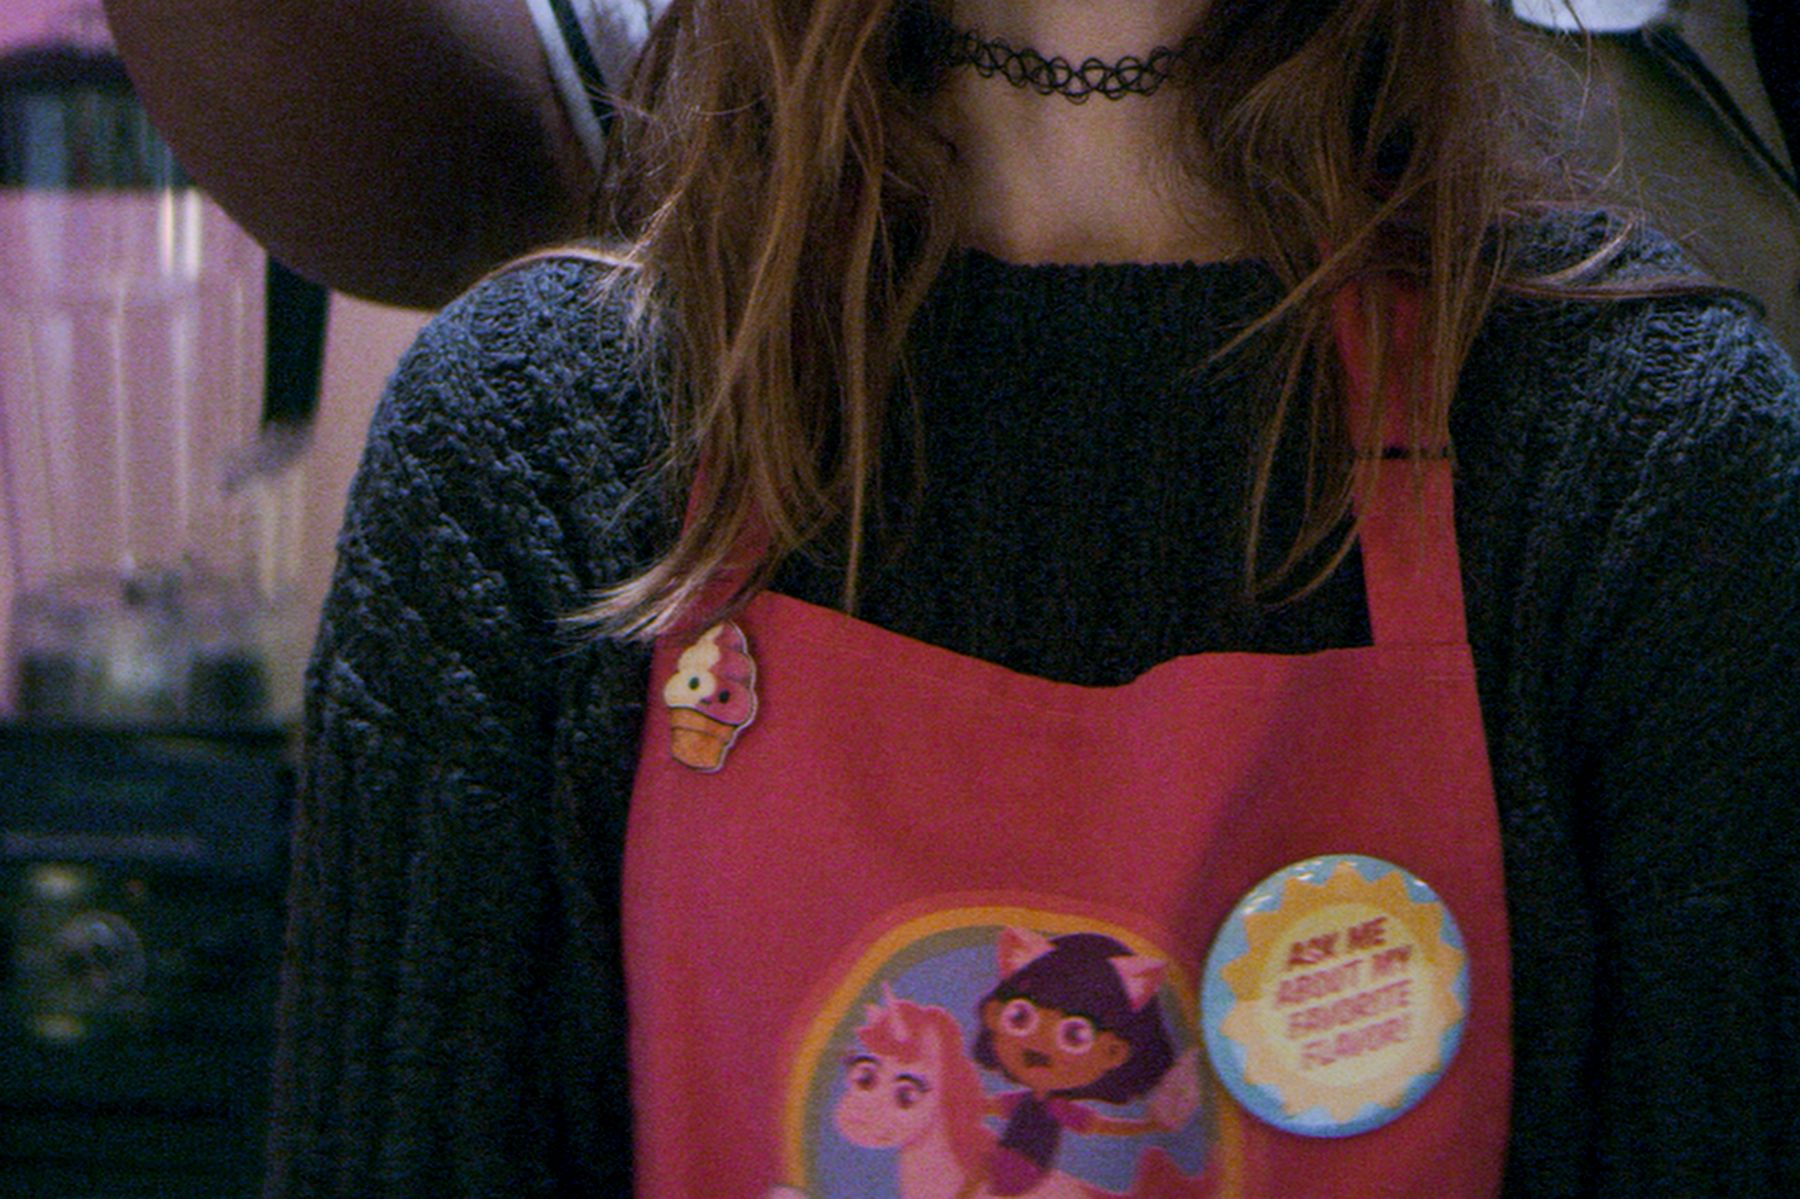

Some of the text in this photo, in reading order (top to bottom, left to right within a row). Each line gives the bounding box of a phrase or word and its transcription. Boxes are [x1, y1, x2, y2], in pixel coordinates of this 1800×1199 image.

[1283, 915, 1387, 970] ASK ME
[1275, 944, 1413, 1009] ABOUT MY
